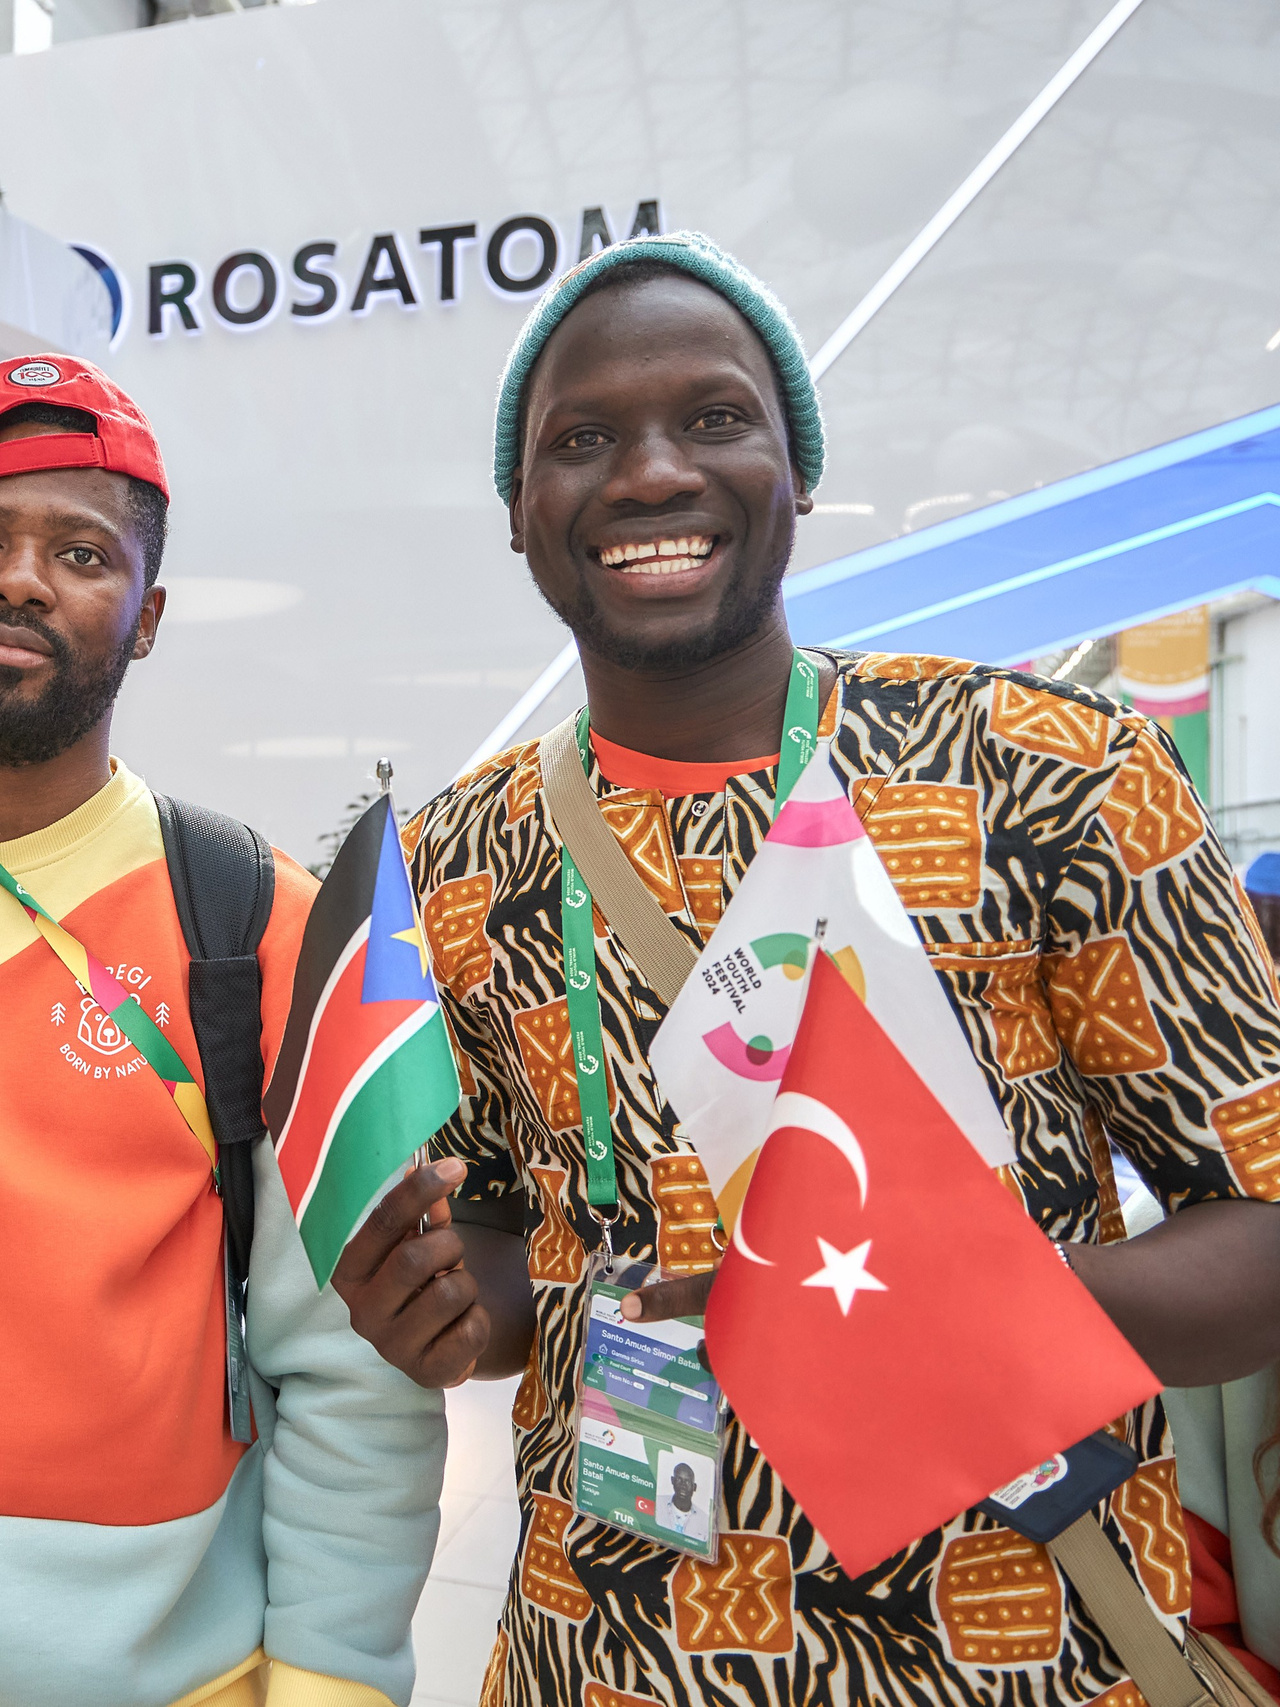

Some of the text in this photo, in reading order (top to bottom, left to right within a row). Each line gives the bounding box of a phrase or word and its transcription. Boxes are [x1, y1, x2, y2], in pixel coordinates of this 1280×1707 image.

[702, 969, 721, 995] 2024
[723, 954, 750, 994] YOUTH
[733, 947, 762, 989] WORLD
[712, 961, 747, 1015] FESTIVAL
[59, 1043, 149, 1079] BORN BY NATU
[602, 1329, 701, 1371] Santo Amude Simon Batali
[611, 1349, 645, 1366] Gamma Sirius
[608, 1372, 622, 1382] Team
[620, 1364, 631, 1372] Court
[582, 1468, 603, 1481] Batali
[583, 1458, 654, 1489] Santo Amude Simon
[614, 1510, 634, 1526] TUR
